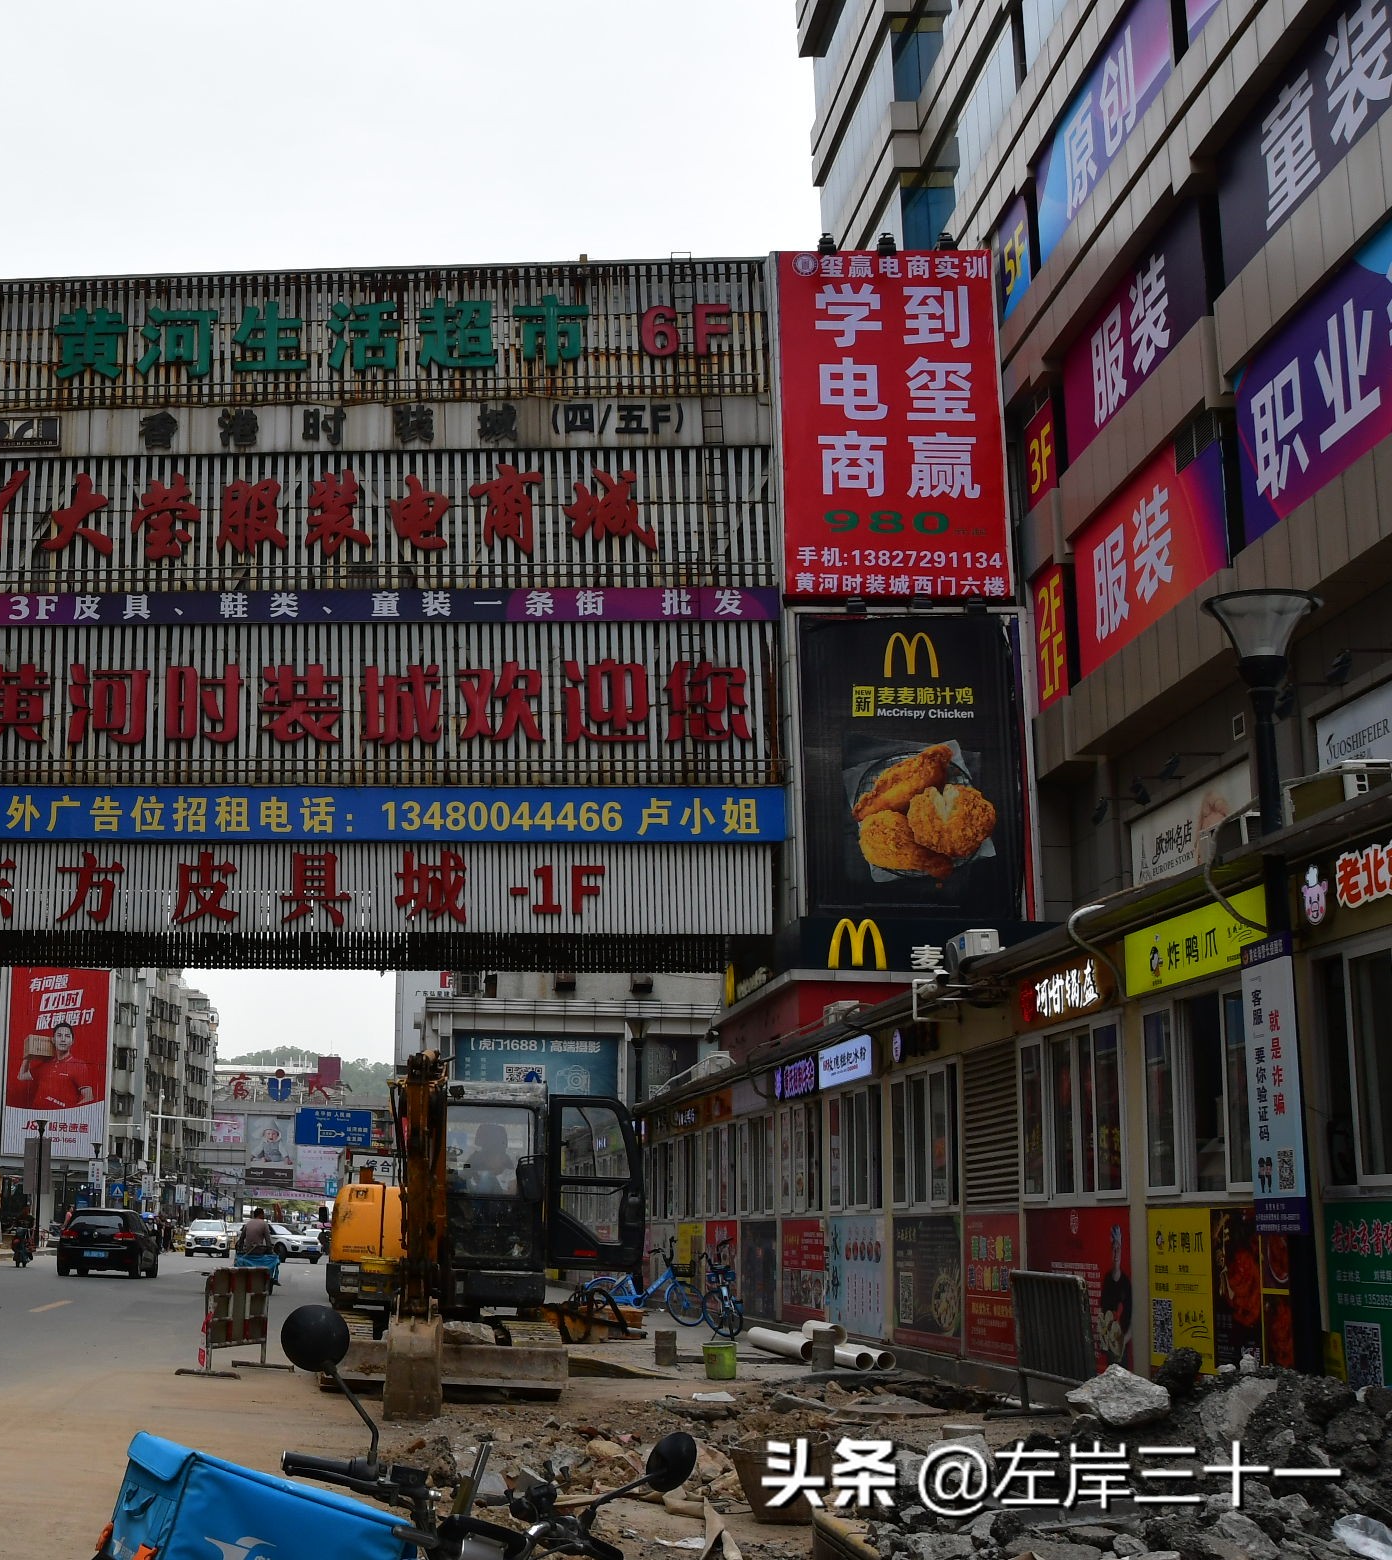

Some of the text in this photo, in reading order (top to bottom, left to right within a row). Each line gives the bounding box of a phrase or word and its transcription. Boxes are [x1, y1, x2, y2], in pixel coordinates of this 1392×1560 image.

[1064, 25, 1137, 221] 原创
[1261, 0, 1392, 231] 童装
[819, 254, 989, 280] 玺赢电商实训
[1004, 221, 1024, 296] 5F
[54, 295, 732, 380] 黄河生活超市 6F
[1090, 253, 1172, 429] 服装
[1250, 262, 1392, 501] 职业
[140, 403, 518, 450] 香港时装城
[1029, 422, 1052, 496] 3F
[823, 510, 951, 536] 980
[795, 573, 1006, 597] 黄河时装城西门六楼
[1093, 484, 1175, 644] 服装
[662, 589, 744, 617] 批发
[1039, 574, 1061, 642] 2F
[1040, 632, 1065, 701] 1F
[877, 687, 975, 705] 麦麦脆汁鸡
[877, 708, 975, 719] McCrispy Chicken
[382, 801, 623, 834] 13480044466
[637, 795, 762, 837] 卢小姐
[1152, 819, 1193, 865] 欧洲名店
[1166, 927, 1219, 971] 炸鸭爪
[29, 974, 69, 992] 有问题
[42, 991, 79, 1009] 1小时
[35, 1007, 95, 1031] 极速赔付
[1267, 1010, 1287, 1117] 就是诈骗
[1168, 1231, 1204, 1253] 炸鸭爪
